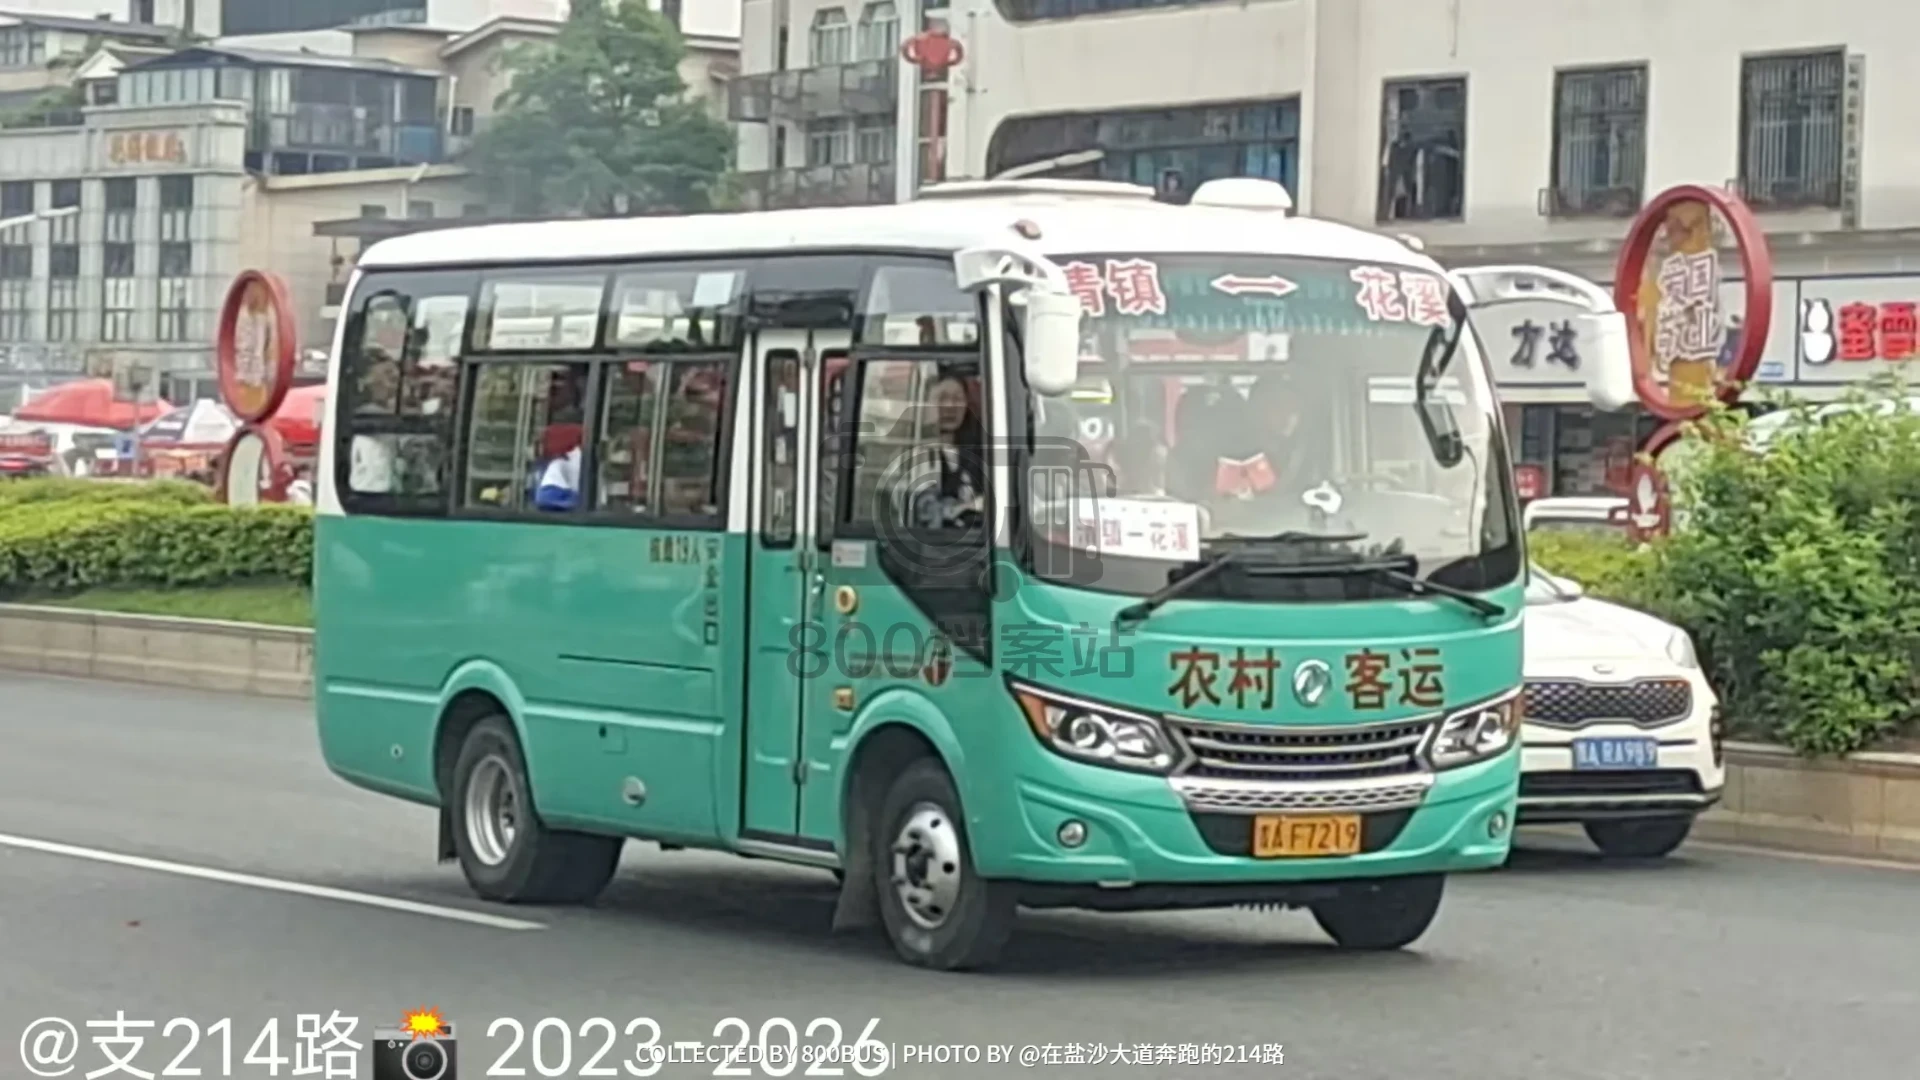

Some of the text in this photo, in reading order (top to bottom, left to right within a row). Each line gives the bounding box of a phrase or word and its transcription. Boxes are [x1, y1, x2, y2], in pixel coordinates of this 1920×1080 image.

[1350, 265, 1449, 328] 花溪
[1661, 252, 1716, 305] 爱国
[1509, 318, 1583, 371] 方达
[1838, 301, 1918, 361] 蜜雪
[704, 537, 720, 646] 安全出口
[1168, 646, 1446, 711] 农村 客运
